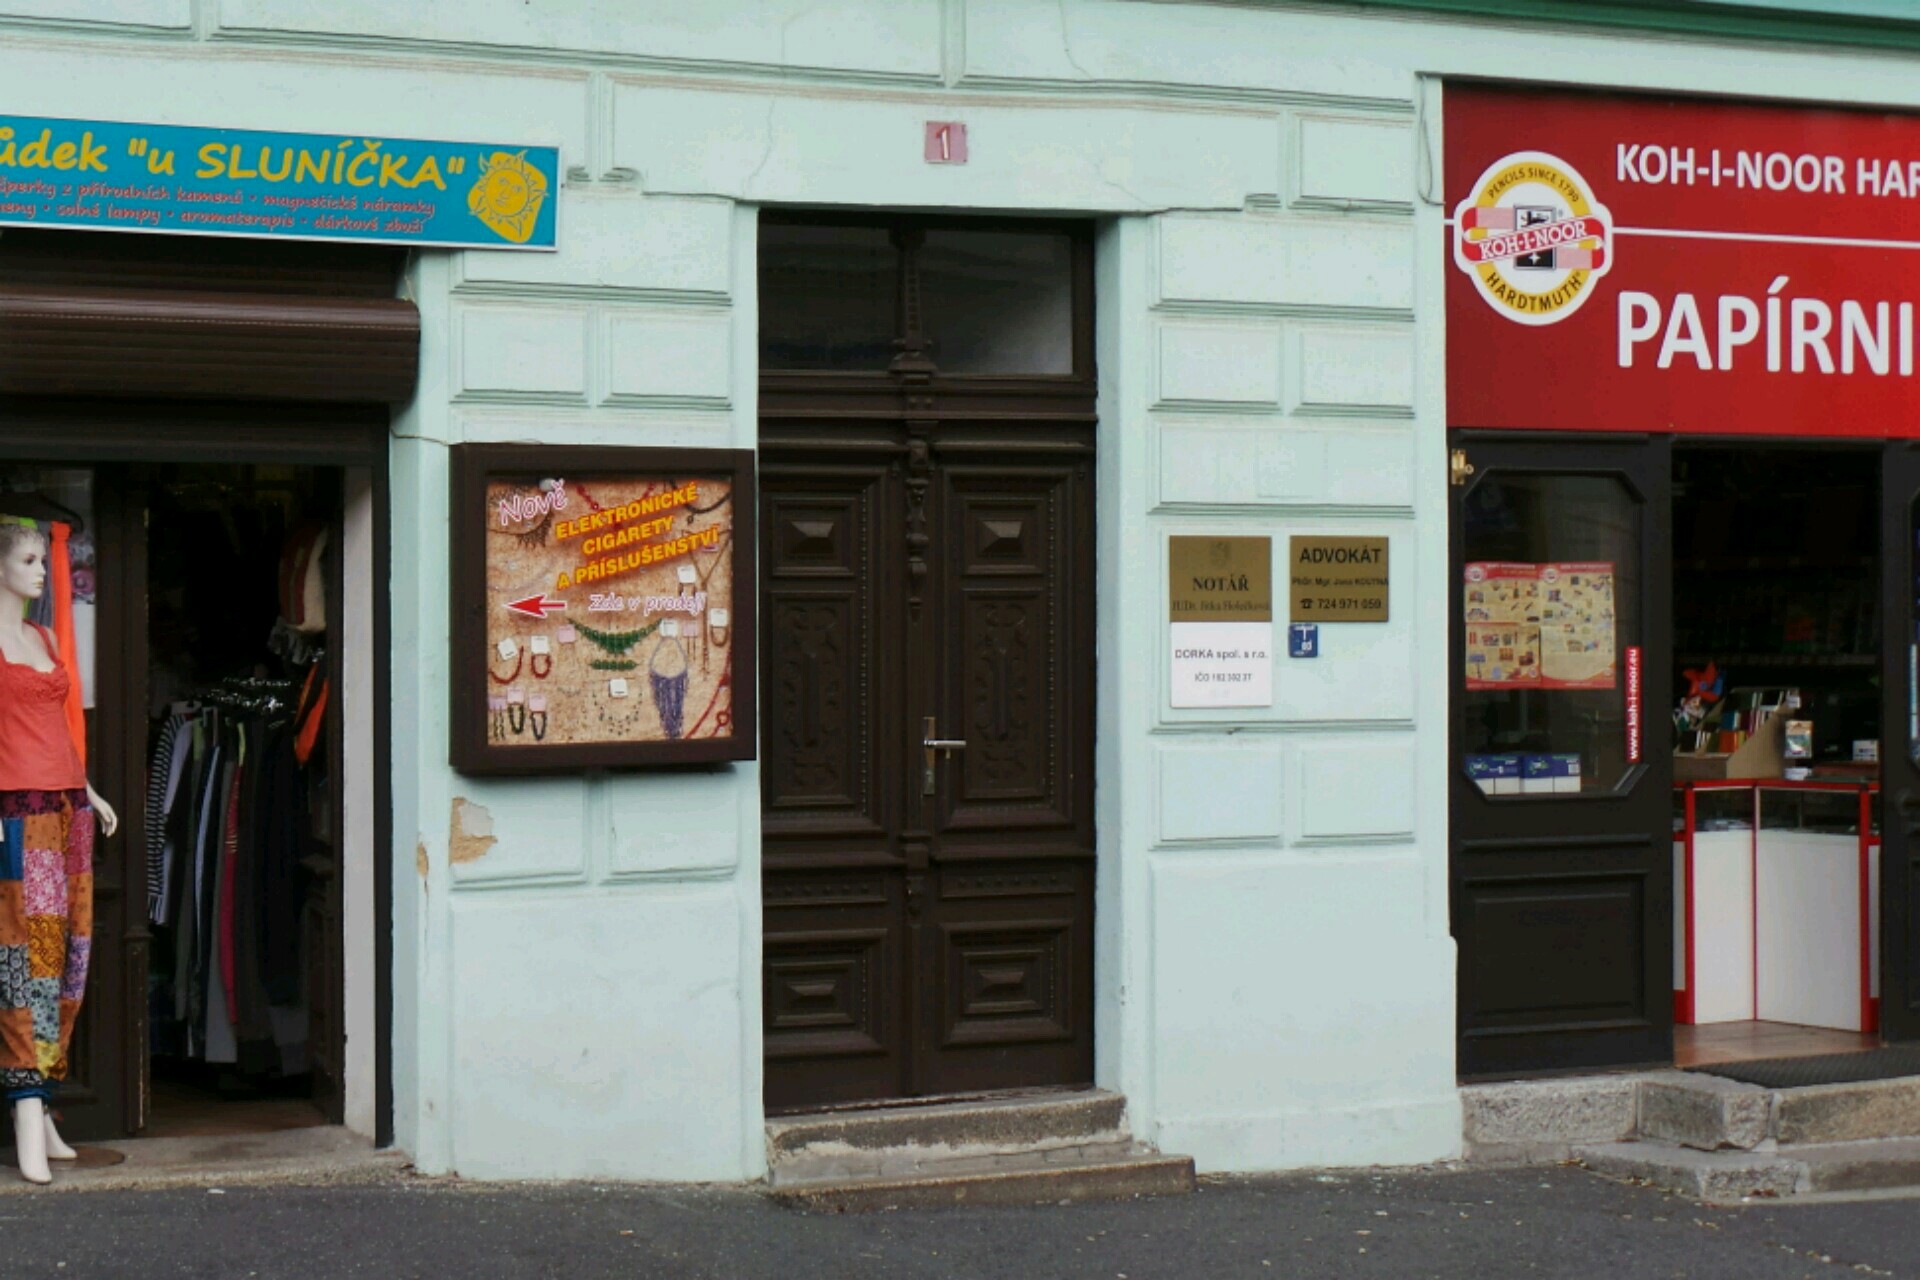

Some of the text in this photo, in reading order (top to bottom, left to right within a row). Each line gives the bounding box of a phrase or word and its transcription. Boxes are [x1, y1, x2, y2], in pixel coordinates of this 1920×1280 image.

[935, 125, 951, 160] 1
[128, 138, 174, 175] "u
[196, 139, 465, 191] SLUNÍČKA"
[1616, 143, 1845, 194] KOH-I-NOOR
[62, 184, 72, 197] z
[364, 197, 435, 219] náramky
[1488, 167, 1579, 203] PENCILS SINCE 1790
[57, 202, 101, 217] solné
[107, 203, 161, 226] lampy
[181, 209, 294, 231] aromaterapie
[1479, 221, 1588, 260] KOH-I-NOOR
[1486, 272, 1583, 312] HARDTMUTH
[1617, 276, 1913, 376] PAPÍRNI
[555, 480, 700, 540] ELEKTRONICKÉ
[582, 515, 675, 556] CIGARETY
[556, 524, 722, 591] A PŘÍSLUŠENSTVÍ
[1299, 547, 1382, 565] ADVOKÁT
[588, 592, 625, 612] Zde
[628, 596, 641, 612] v
[1192, 573, 1249, 592] NOTÁŘ
